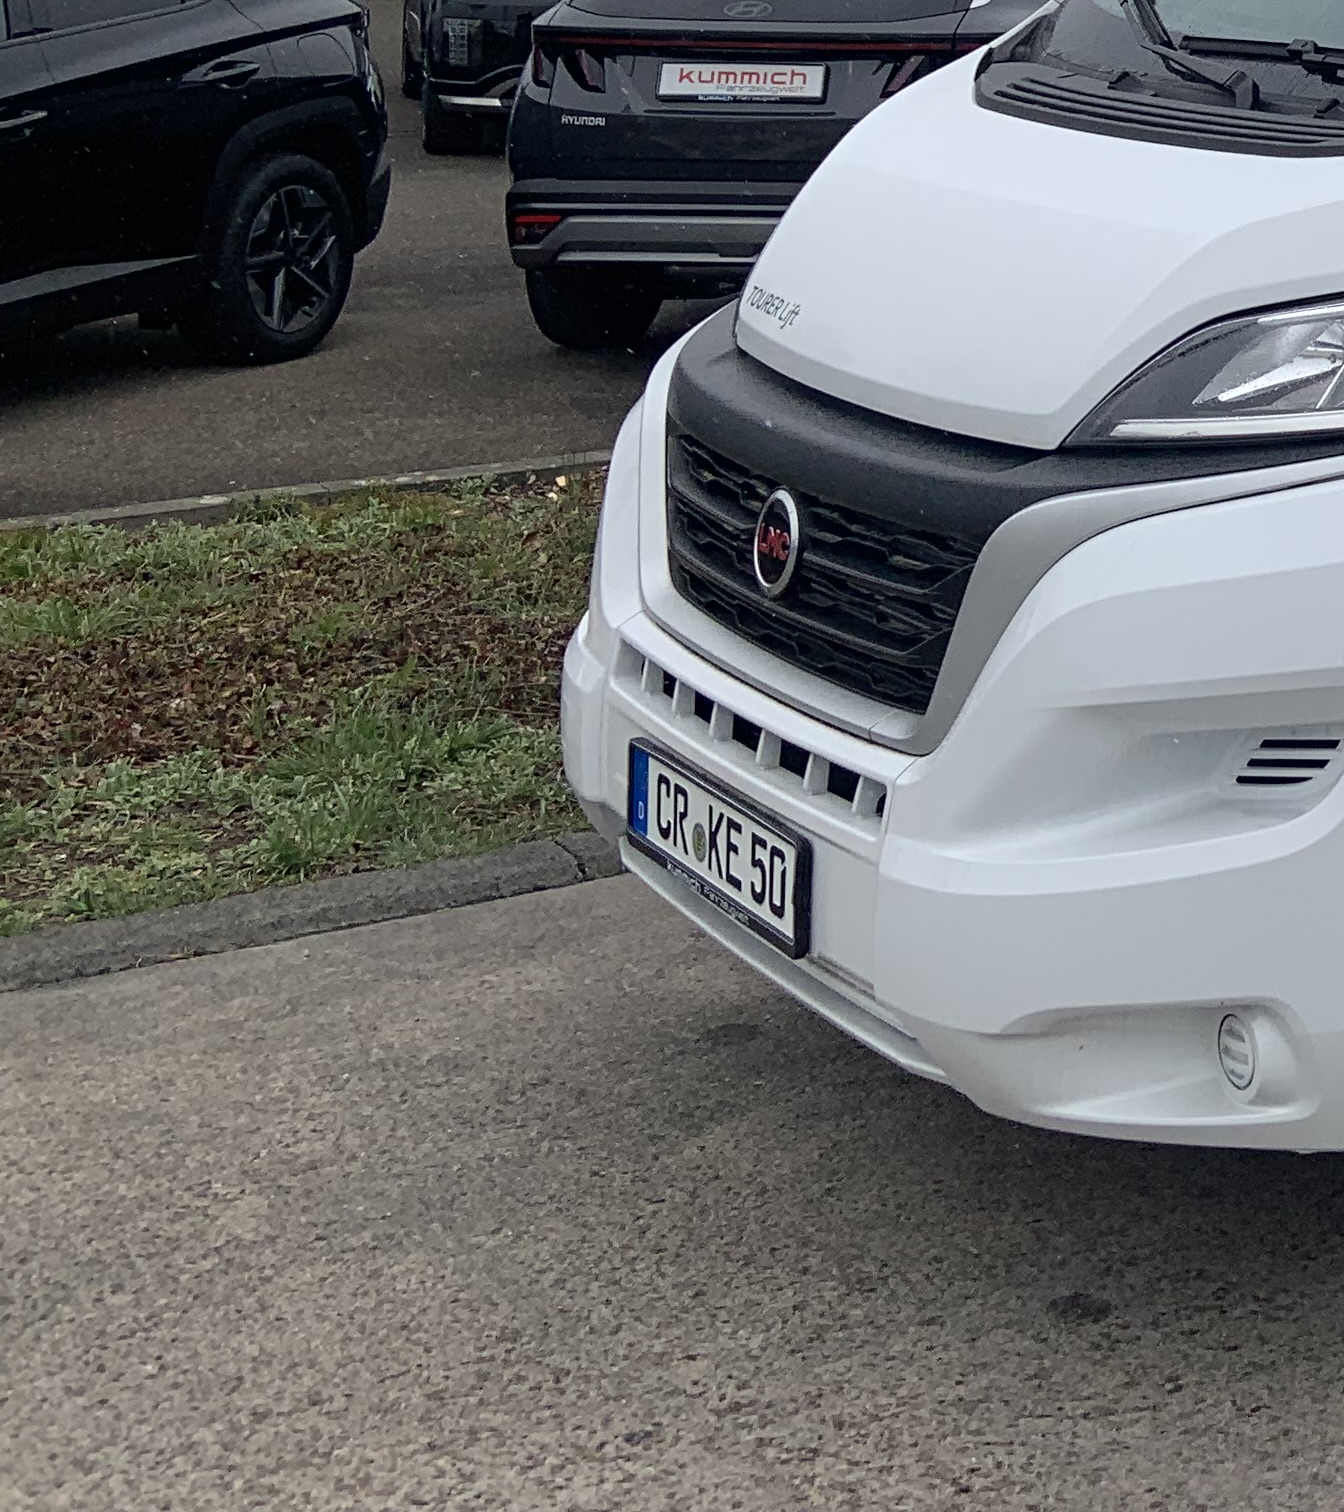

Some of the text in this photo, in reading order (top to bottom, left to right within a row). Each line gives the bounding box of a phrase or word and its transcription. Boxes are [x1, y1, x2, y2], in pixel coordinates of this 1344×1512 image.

[679, 67, 807, 85] kummich
[561, 114, 606, 126] HYUNDAI
[746, 285, 801, 329] TOURER Lift
[758, 523, 790, 561] LMC
[638, 801, 645, 820] D
[657, 773, 787, 920] CR KE 50
